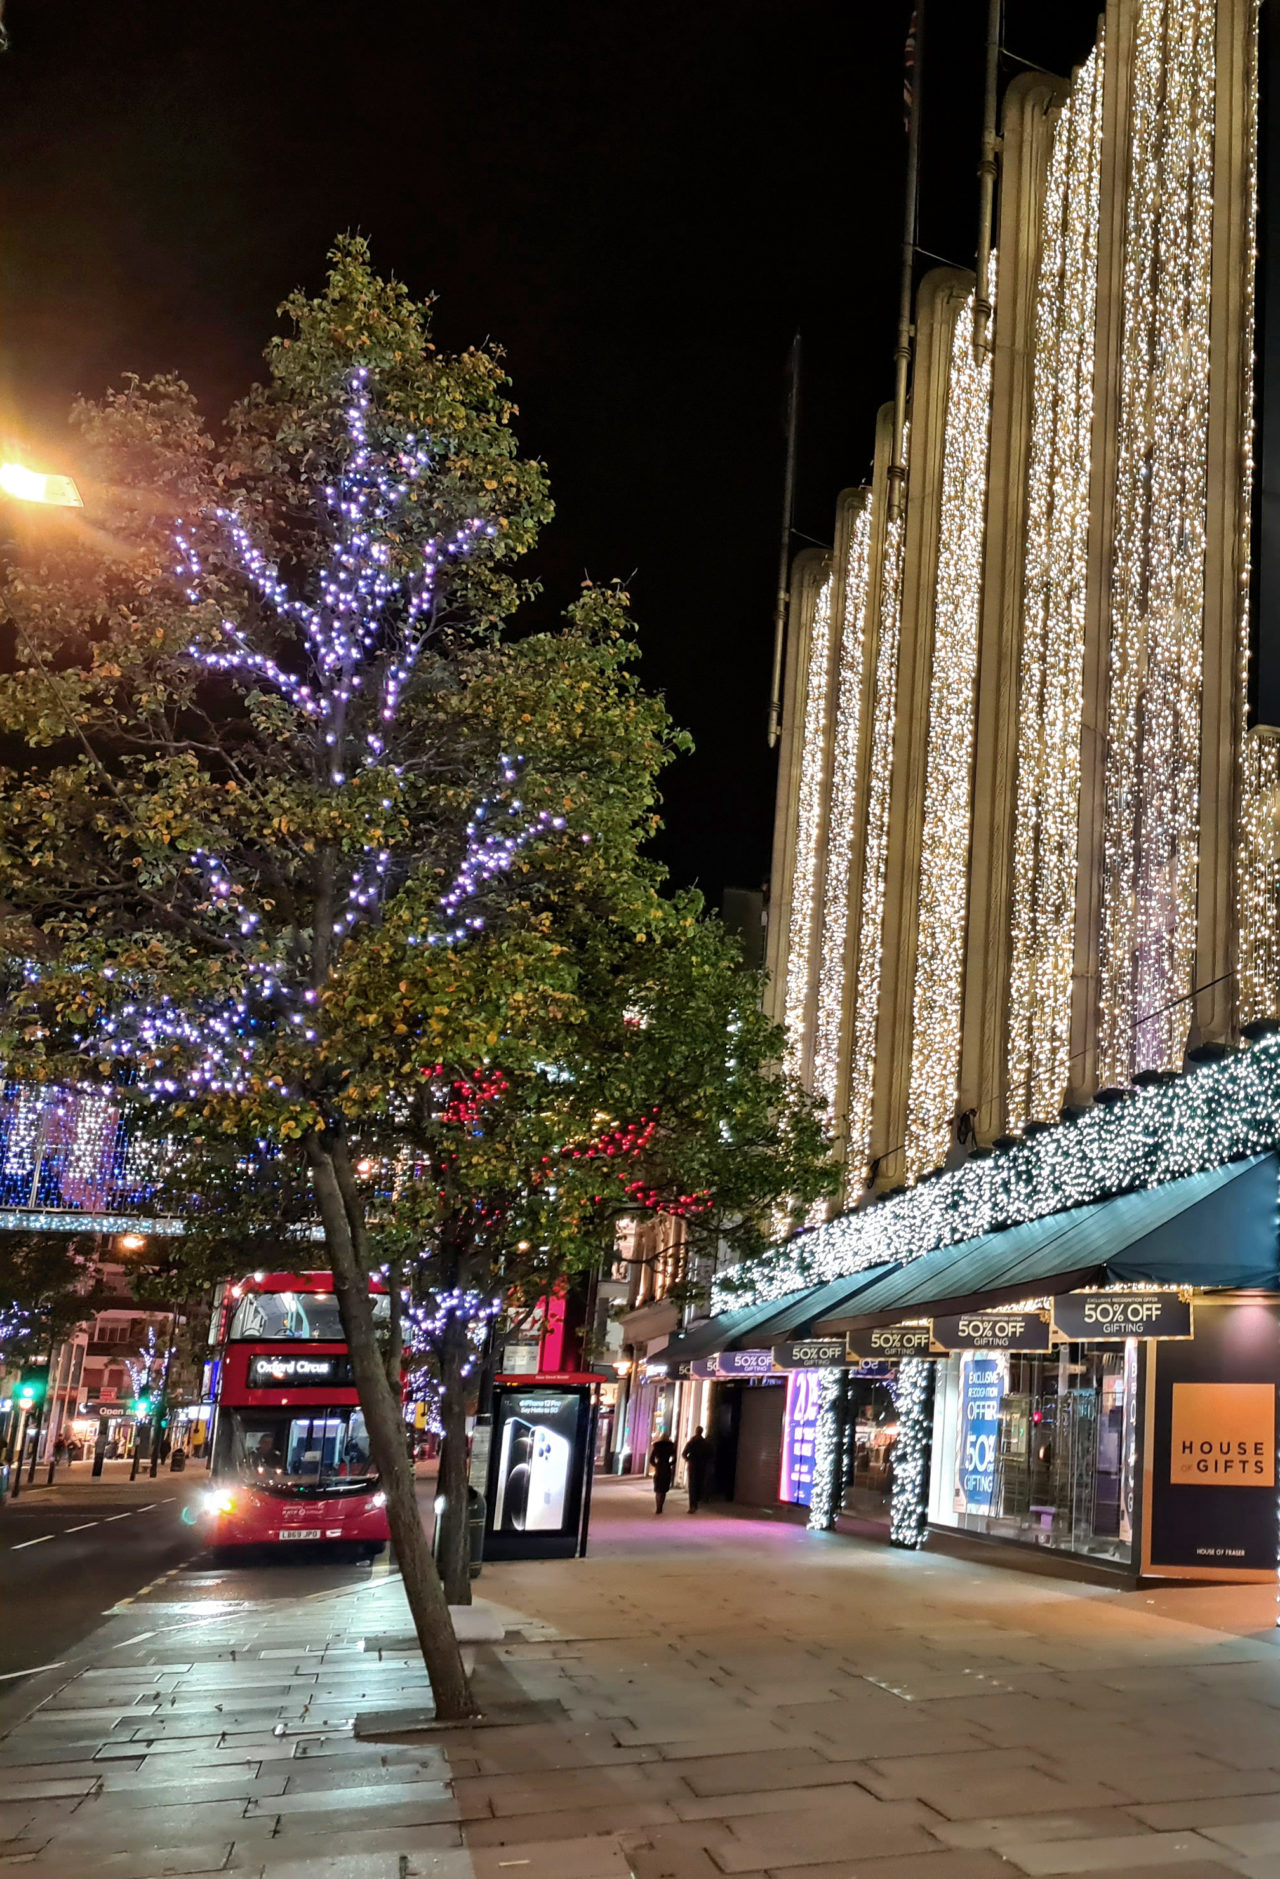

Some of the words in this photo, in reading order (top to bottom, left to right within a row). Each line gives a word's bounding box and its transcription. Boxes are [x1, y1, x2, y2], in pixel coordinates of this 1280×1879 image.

[1084, 1303, 1124, 1323] 50%
[1127, 1303, 1162, 1322] OFF
[958, 1320, 994, 1338] 50%
[995, 1321, 1025, 1338] OFF
[1103, 1323, 1144, 1333] GIFTING
[871, 1333, 901, 1348] 50%
[903, 1334, 929, 1348] OFF
[973, 1337, 1009, 1347] GIFTING
[792, 1347, 818, 1360] 50%
[819, 1347, 842, 1359] OFF
[884, 1347, 915, 1355] GIFTING
[257, 1360, 295, 1373] Oxford
[296, 1360, 329, 1373] Circus
[707, 1361, 718, 1371] 50
[735, 1356, 757, 1367] 50%
[758, 1356, 772, 1366] OF
[679, 1365, 691, 1375] 50
[968, 1371, 999, 1384] EXCLUSIVE
[99, 1406, 124, 1416] Open
[967, 1401, 997, 1420] OFFER
[965, 1434, 997, 1472] 50%
[1182, 1441, 1264, 1456] HOUSE
[1196, 1459, 1264, 1474] GIFTS
[964, 1474, 993, 1493] GIFTING
[1196, 1548, 1215, 1556] HOUSE
[1225, 1549, 1245, 1557] FRASER
